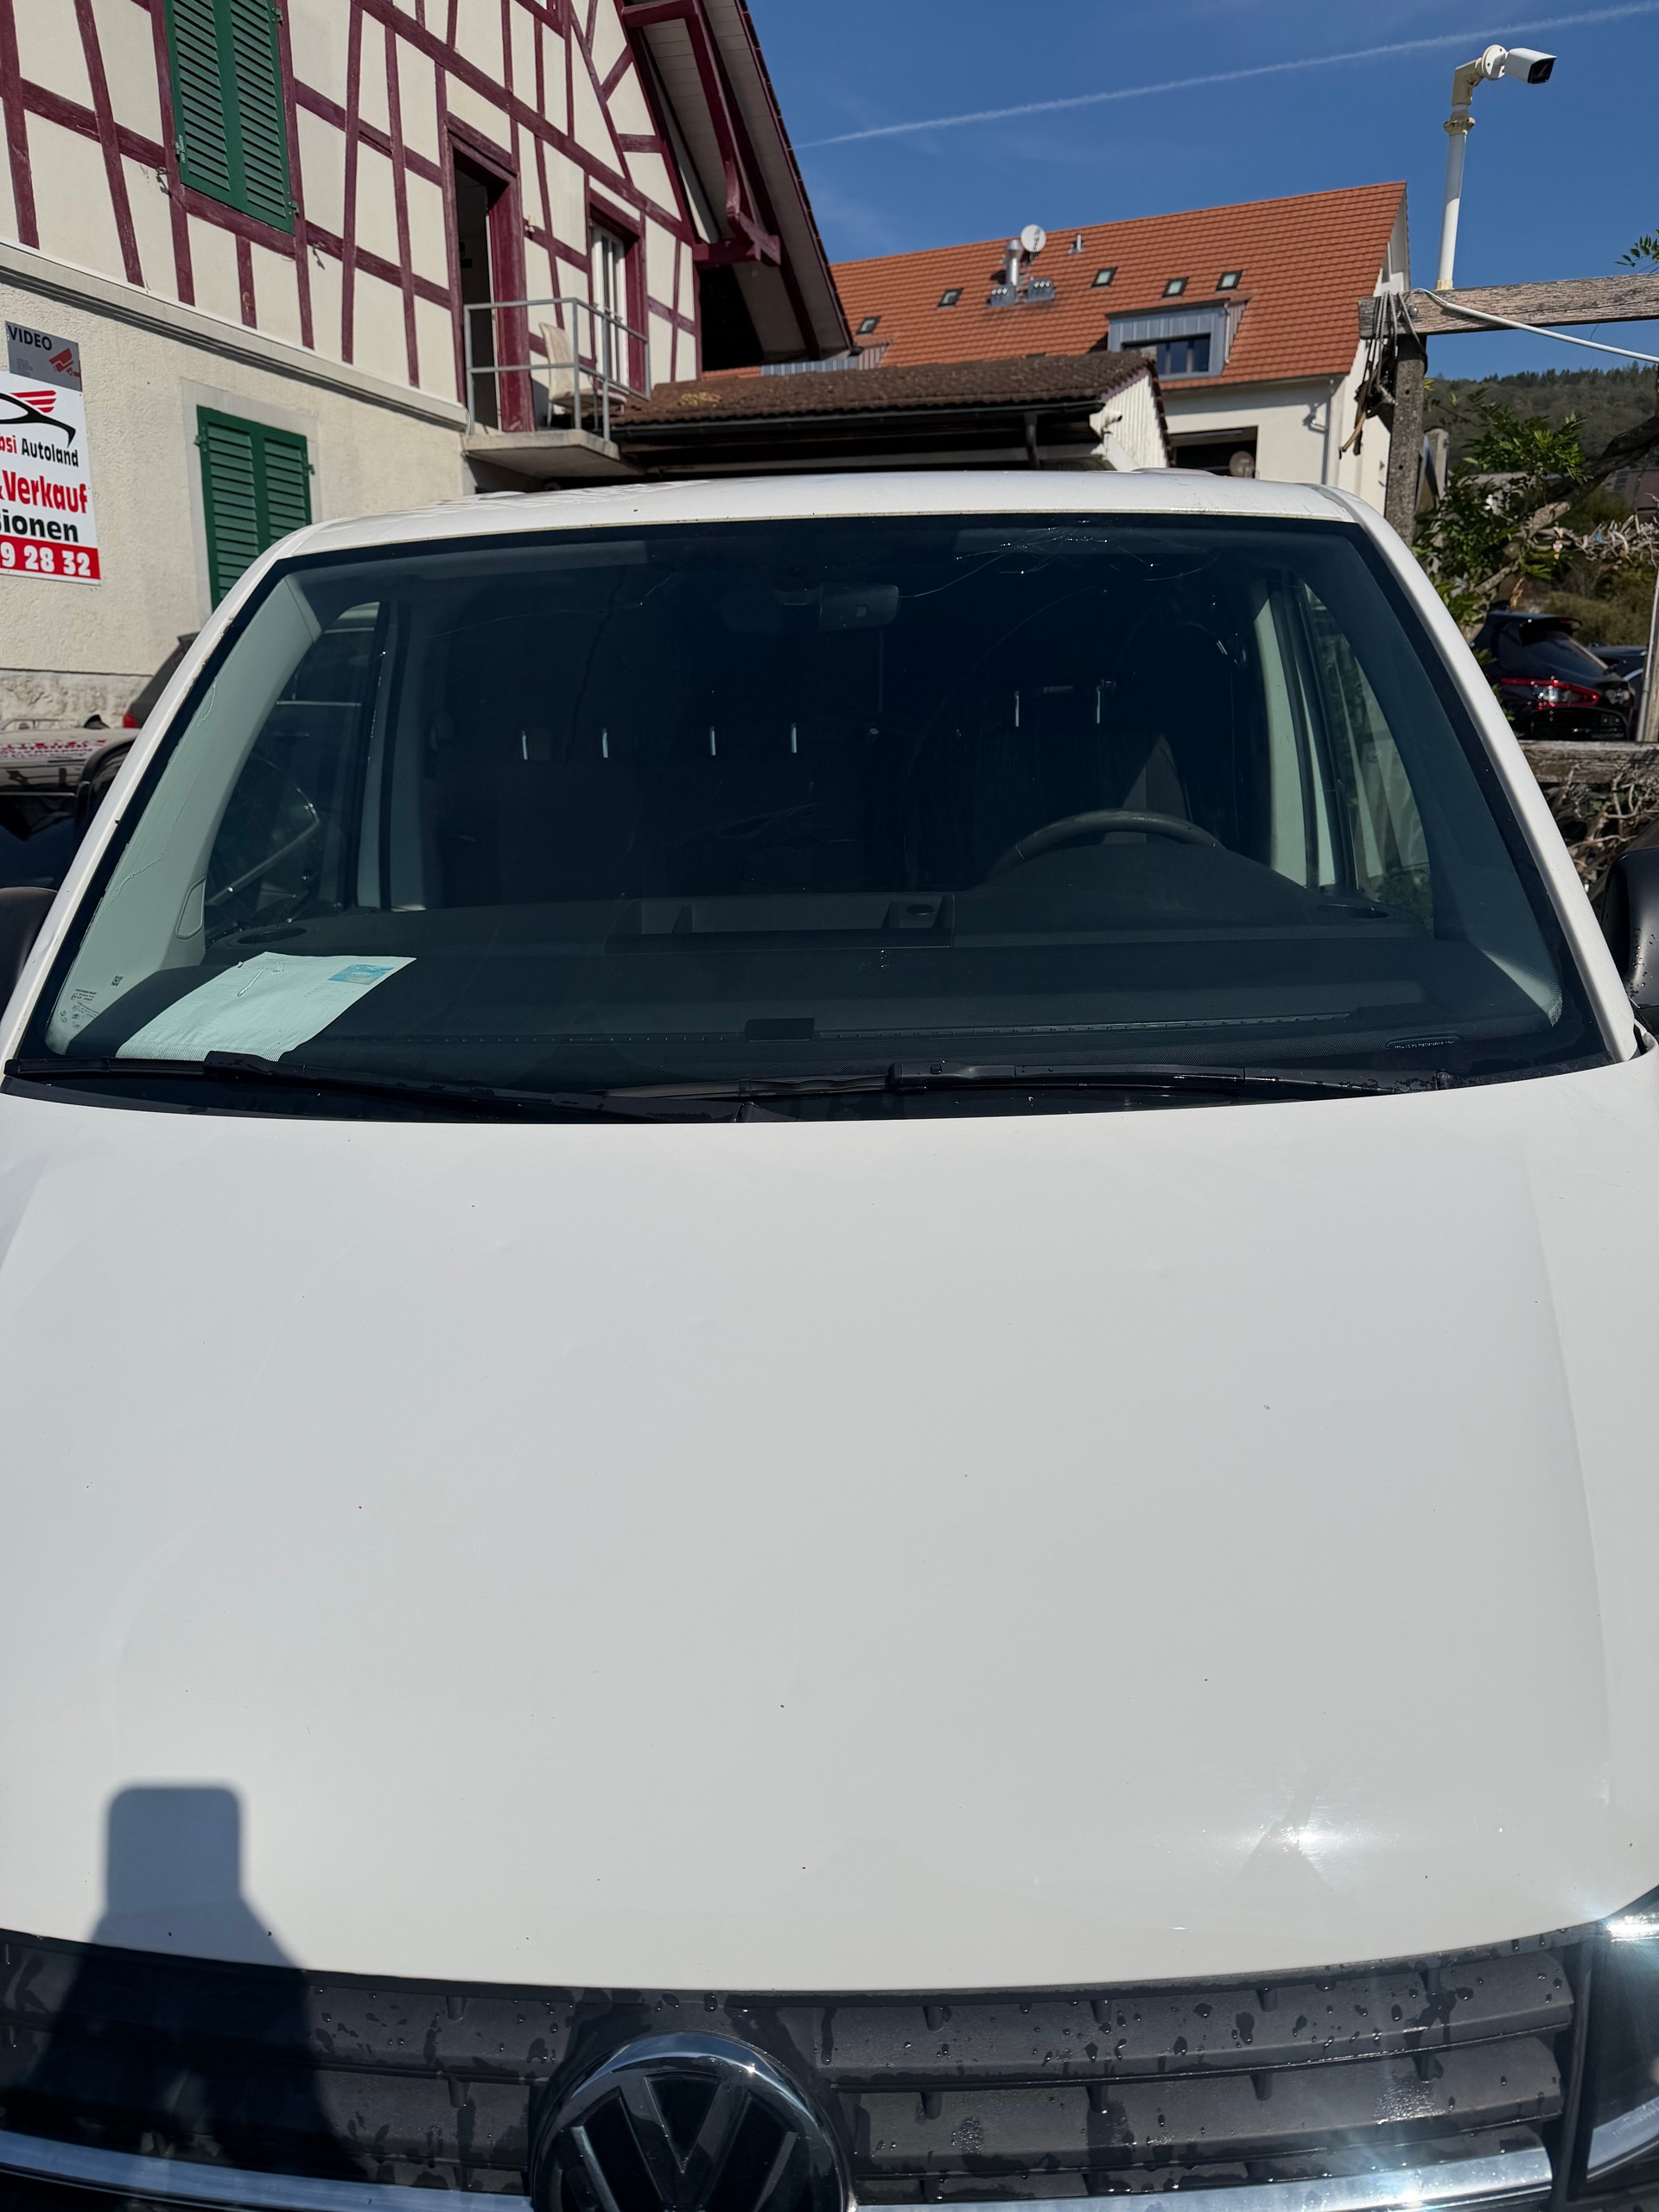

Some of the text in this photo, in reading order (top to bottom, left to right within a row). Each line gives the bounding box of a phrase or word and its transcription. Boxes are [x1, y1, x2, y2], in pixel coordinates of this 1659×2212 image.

[8, 325, 53, 351] VIDEO
[22, 437, 79, 467] Autoland
[0, 469, 87, 514] Verkauf
[0, 508, 79, 543] ionen
[23, 544, 54, 574] 28
[62, 550, 91, 577] 32
